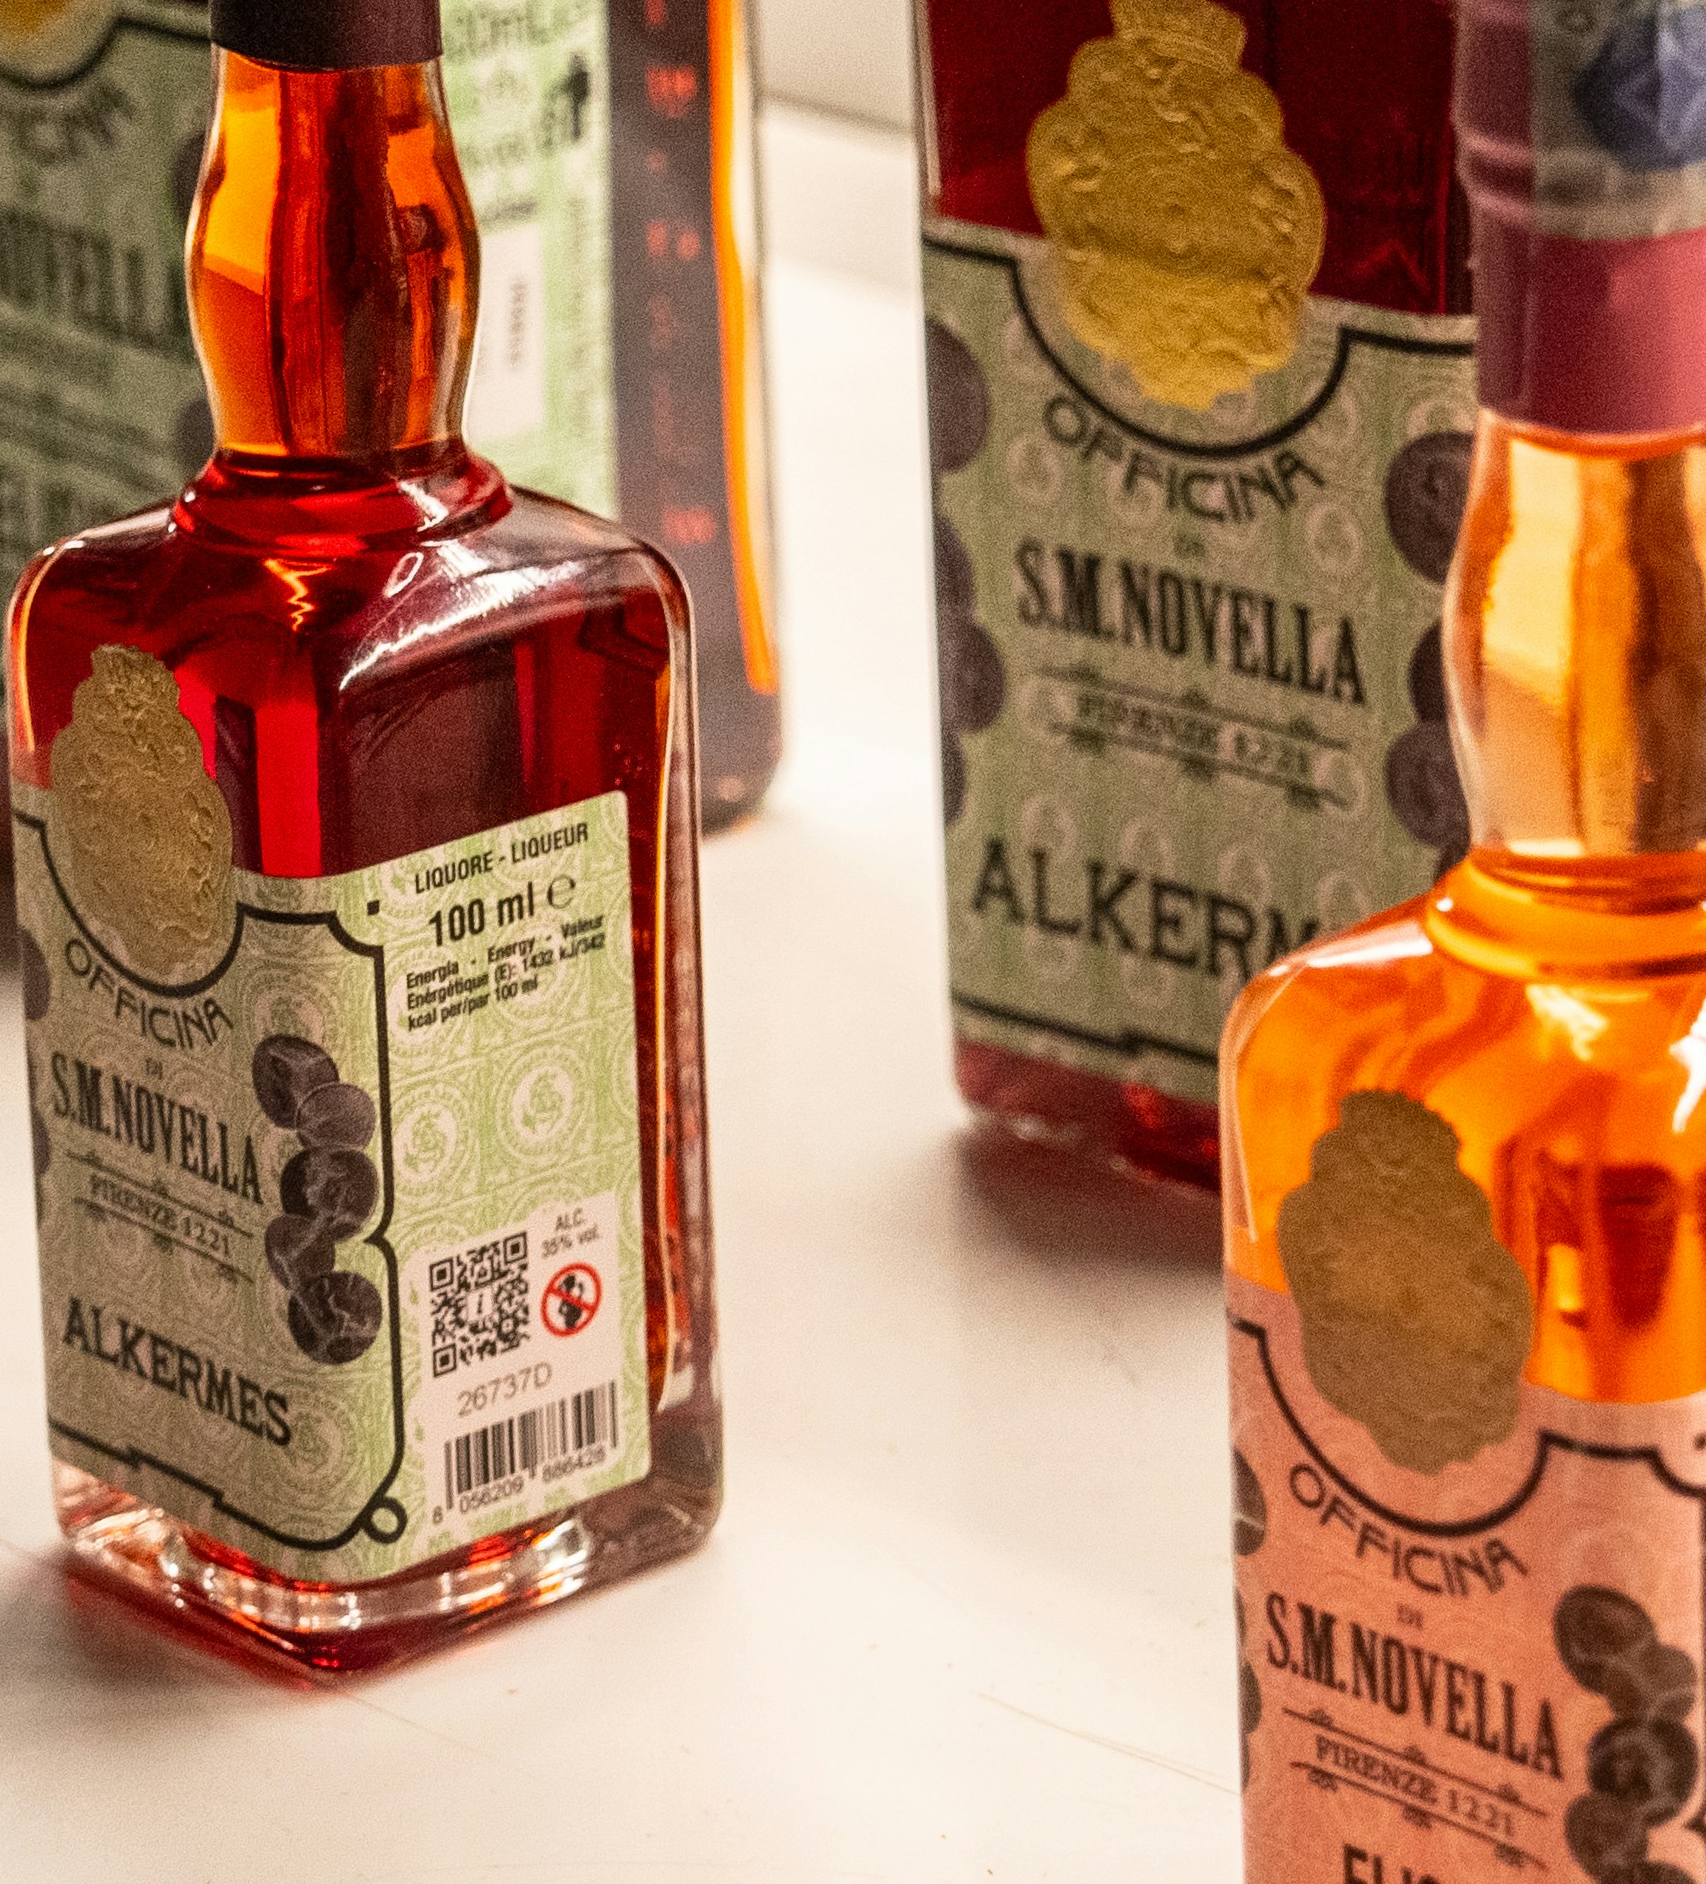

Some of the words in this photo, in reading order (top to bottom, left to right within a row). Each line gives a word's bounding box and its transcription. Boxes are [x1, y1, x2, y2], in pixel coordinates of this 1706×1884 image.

[1042, 392, 1326, 524] OFFICINA
[415, 850, 494, 895] LIQUORE
[510, 821, 589, 864] LIQUEUR
[428, 897, 485, 948] 100
[497, 881, 535, 928] ml
[487, 936, 536, 964] Energy
[64, 938, 234, 1051] OFFICINA
[408, 1006, 437, 1031] kcal
[495, 980, 517, 1001] 100
[180, 1217, 232, 1257] 1221
[64, 1296, 292, 1447] ALKERMES
[457, 1362, 553, 1417] 26737D
[1289, 1463, 1529, 1597] OFFICINA
[1316, 1735, 1439, 1805] FIRENZE
[1448, 1789, 1517, 1836] 1221
